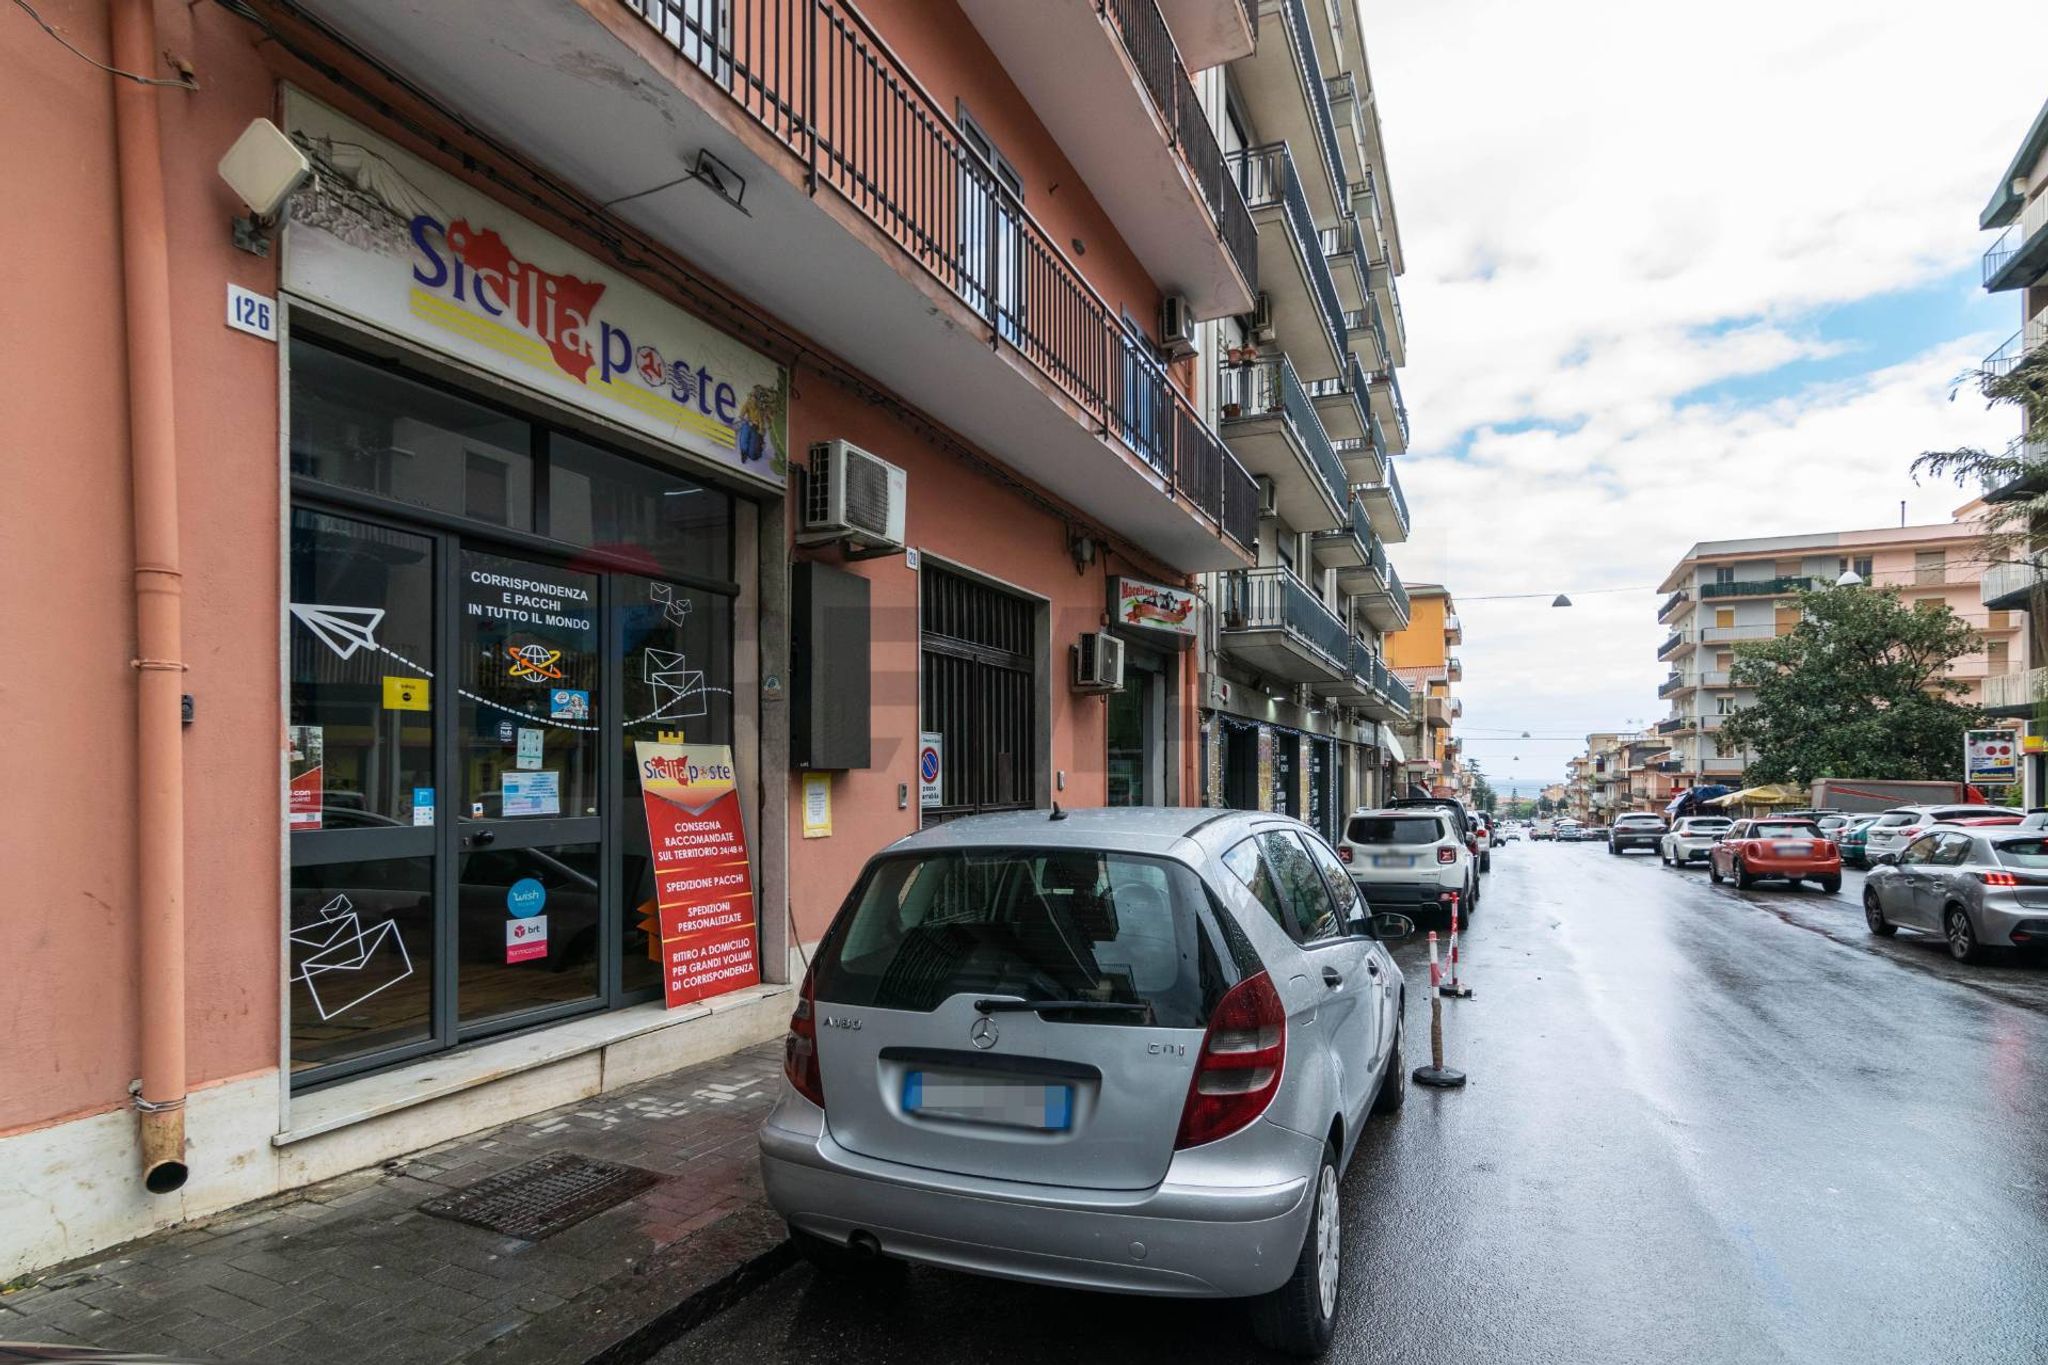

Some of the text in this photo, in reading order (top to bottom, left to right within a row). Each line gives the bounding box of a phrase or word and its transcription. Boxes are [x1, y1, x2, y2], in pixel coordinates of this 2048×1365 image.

[236, 296, 270, 331] 126
[471, 571, 588, 601] CORRISPONDENZA
[503, 593, 561, 611] E PACCHI
[468, 603, 590, 630] IN TUTTO IL MONDO
[674, 821, 721, 832] CONSEGNA
[664, 832, 735, 847] RACCOMANDATE
[658, 850, 673, 861] SUL
[674, 847, 718, 860] TERRITORIO
[666, 873, 744, 893] SPEDIZIONE PACCHI
[687, 902, 731, 917] SPEDIZIONI
[528, 925, 540, 934] brt
[678, 912, 742, 932] PERSONALIZZATE
[672, 938, 750, 963] RITIRO A DOMICILIO
[672, 950, 752, 977] PER GRANDI VOLUMI
[672, 963, 754, 991] DI CORRISPONDENZA
